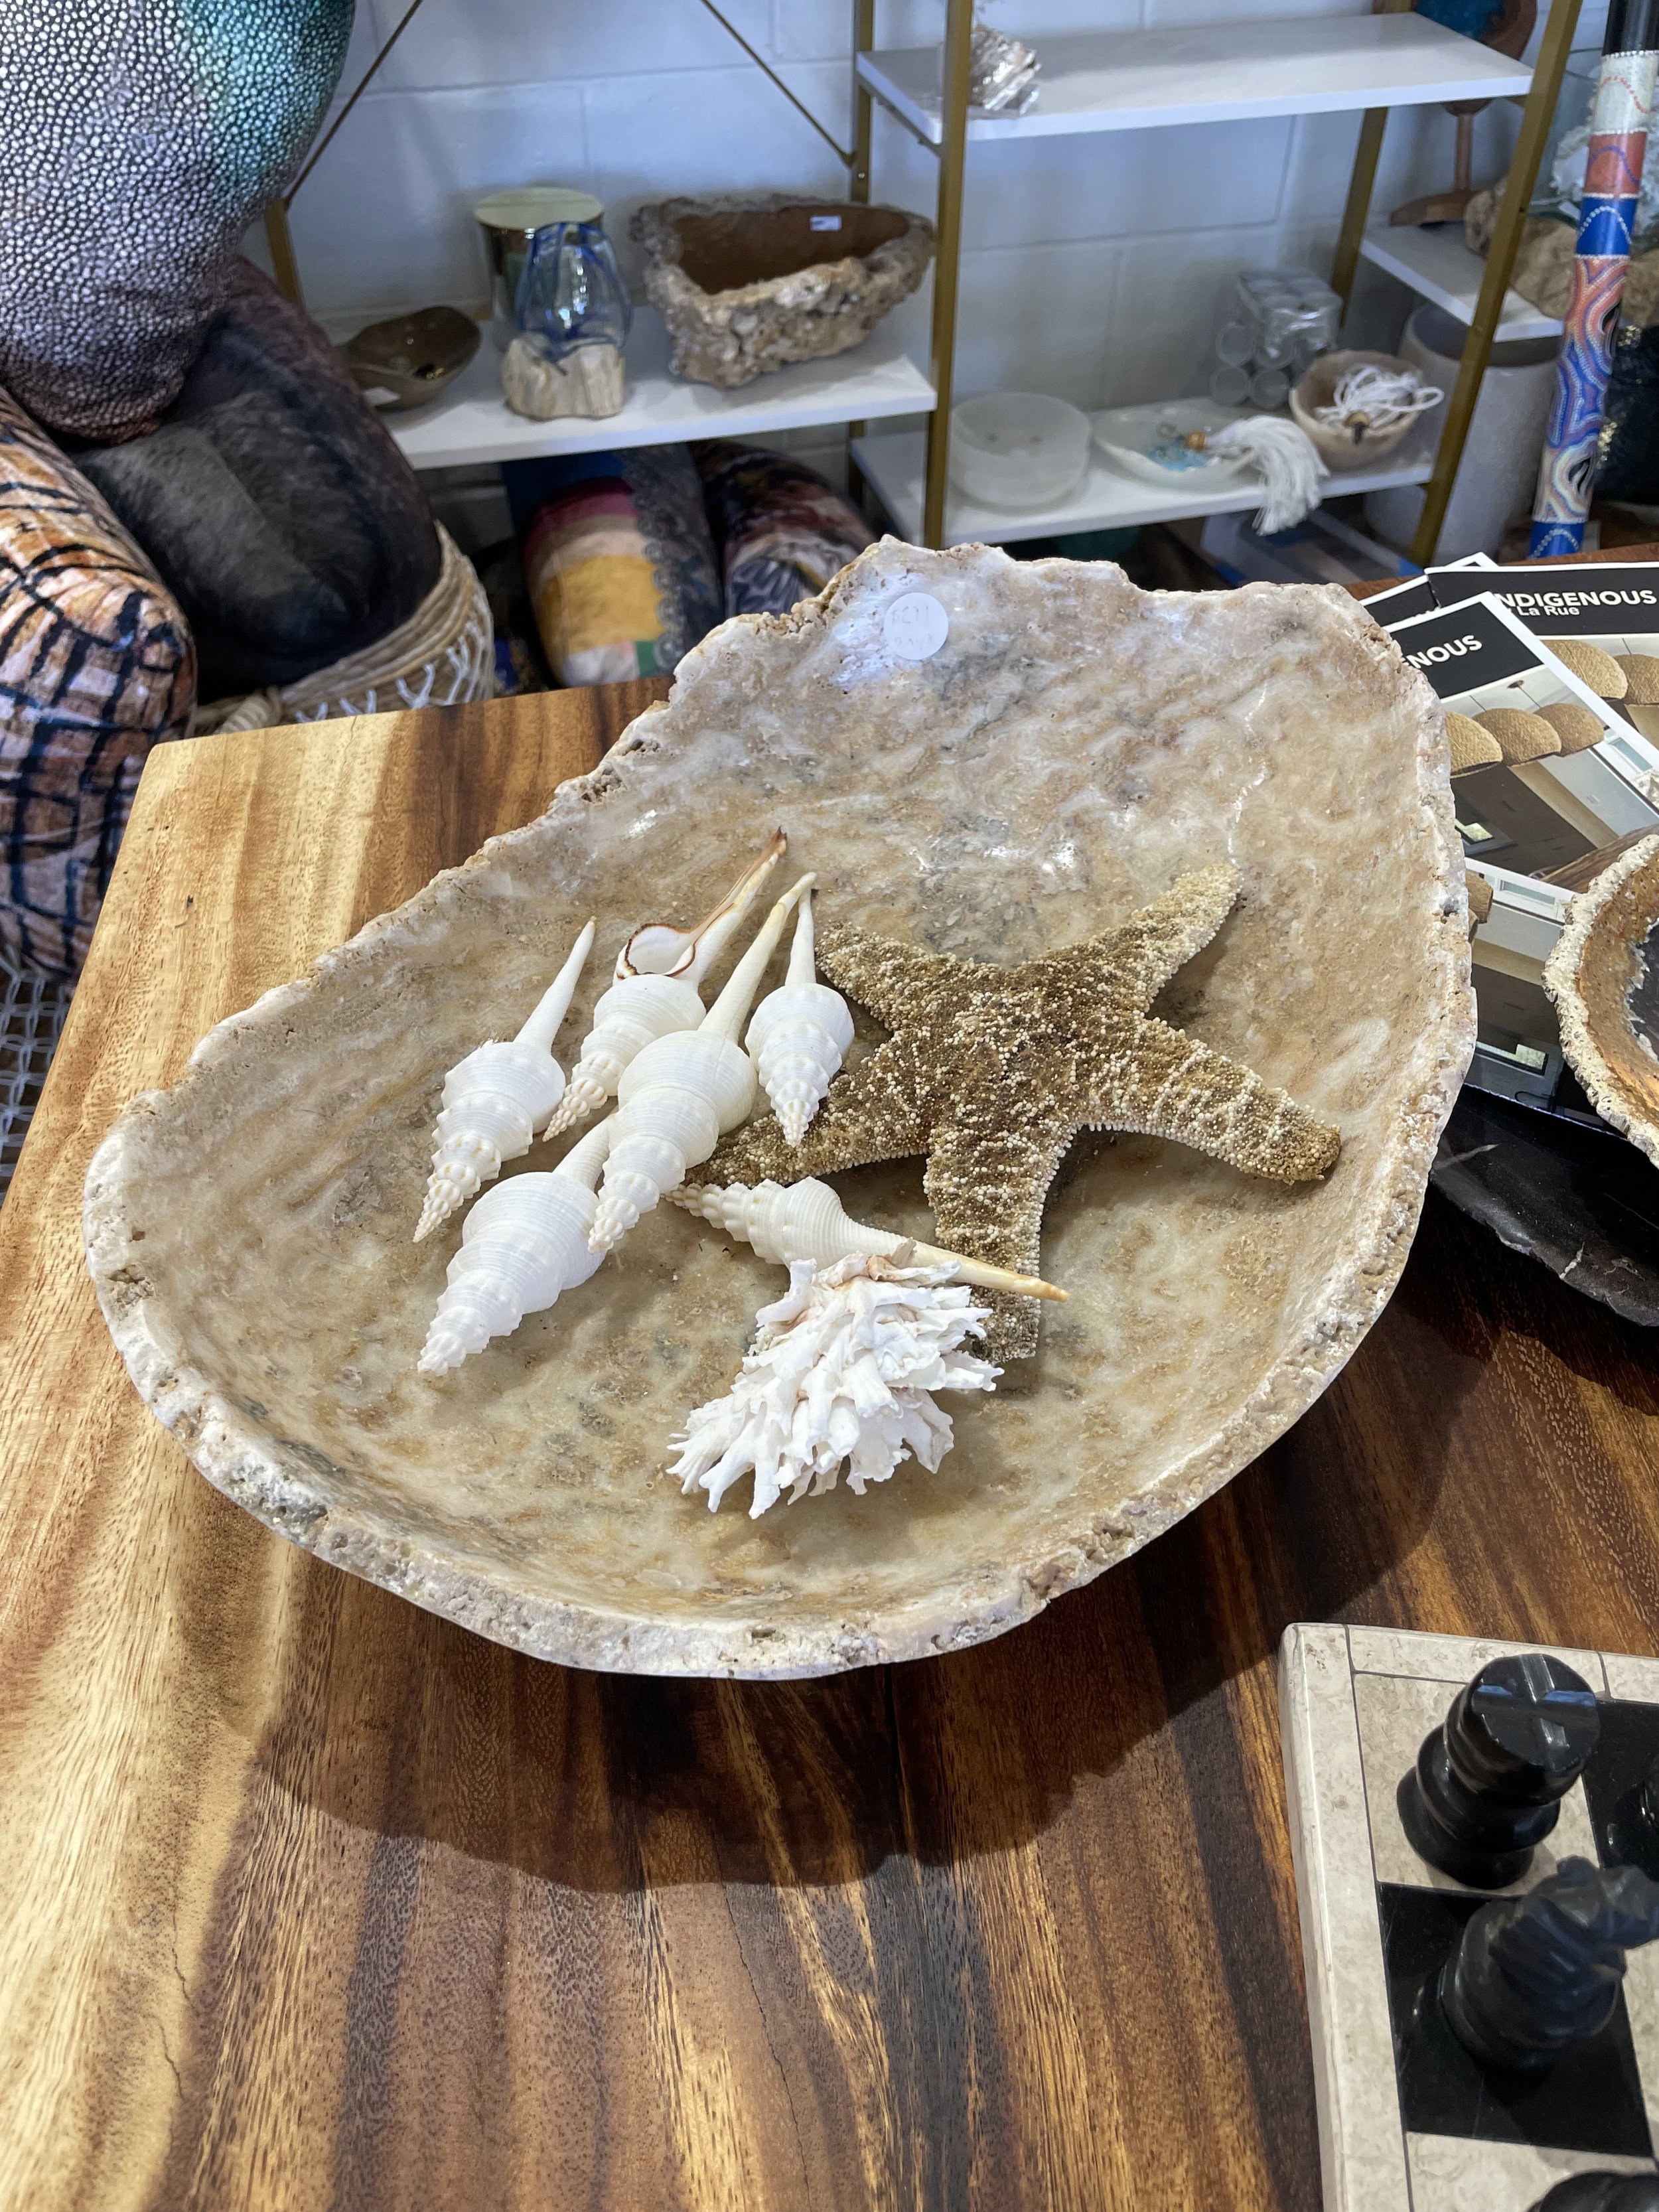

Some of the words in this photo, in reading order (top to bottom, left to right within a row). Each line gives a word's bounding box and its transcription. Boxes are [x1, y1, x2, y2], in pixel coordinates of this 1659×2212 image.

[1493, 589, 1658, 607] NDIGENOUS
[1516, 605, 1541, 616] La
[1544, 605, 1581, 616] Rue
[1404, 634, 1482, 669] NOUS
